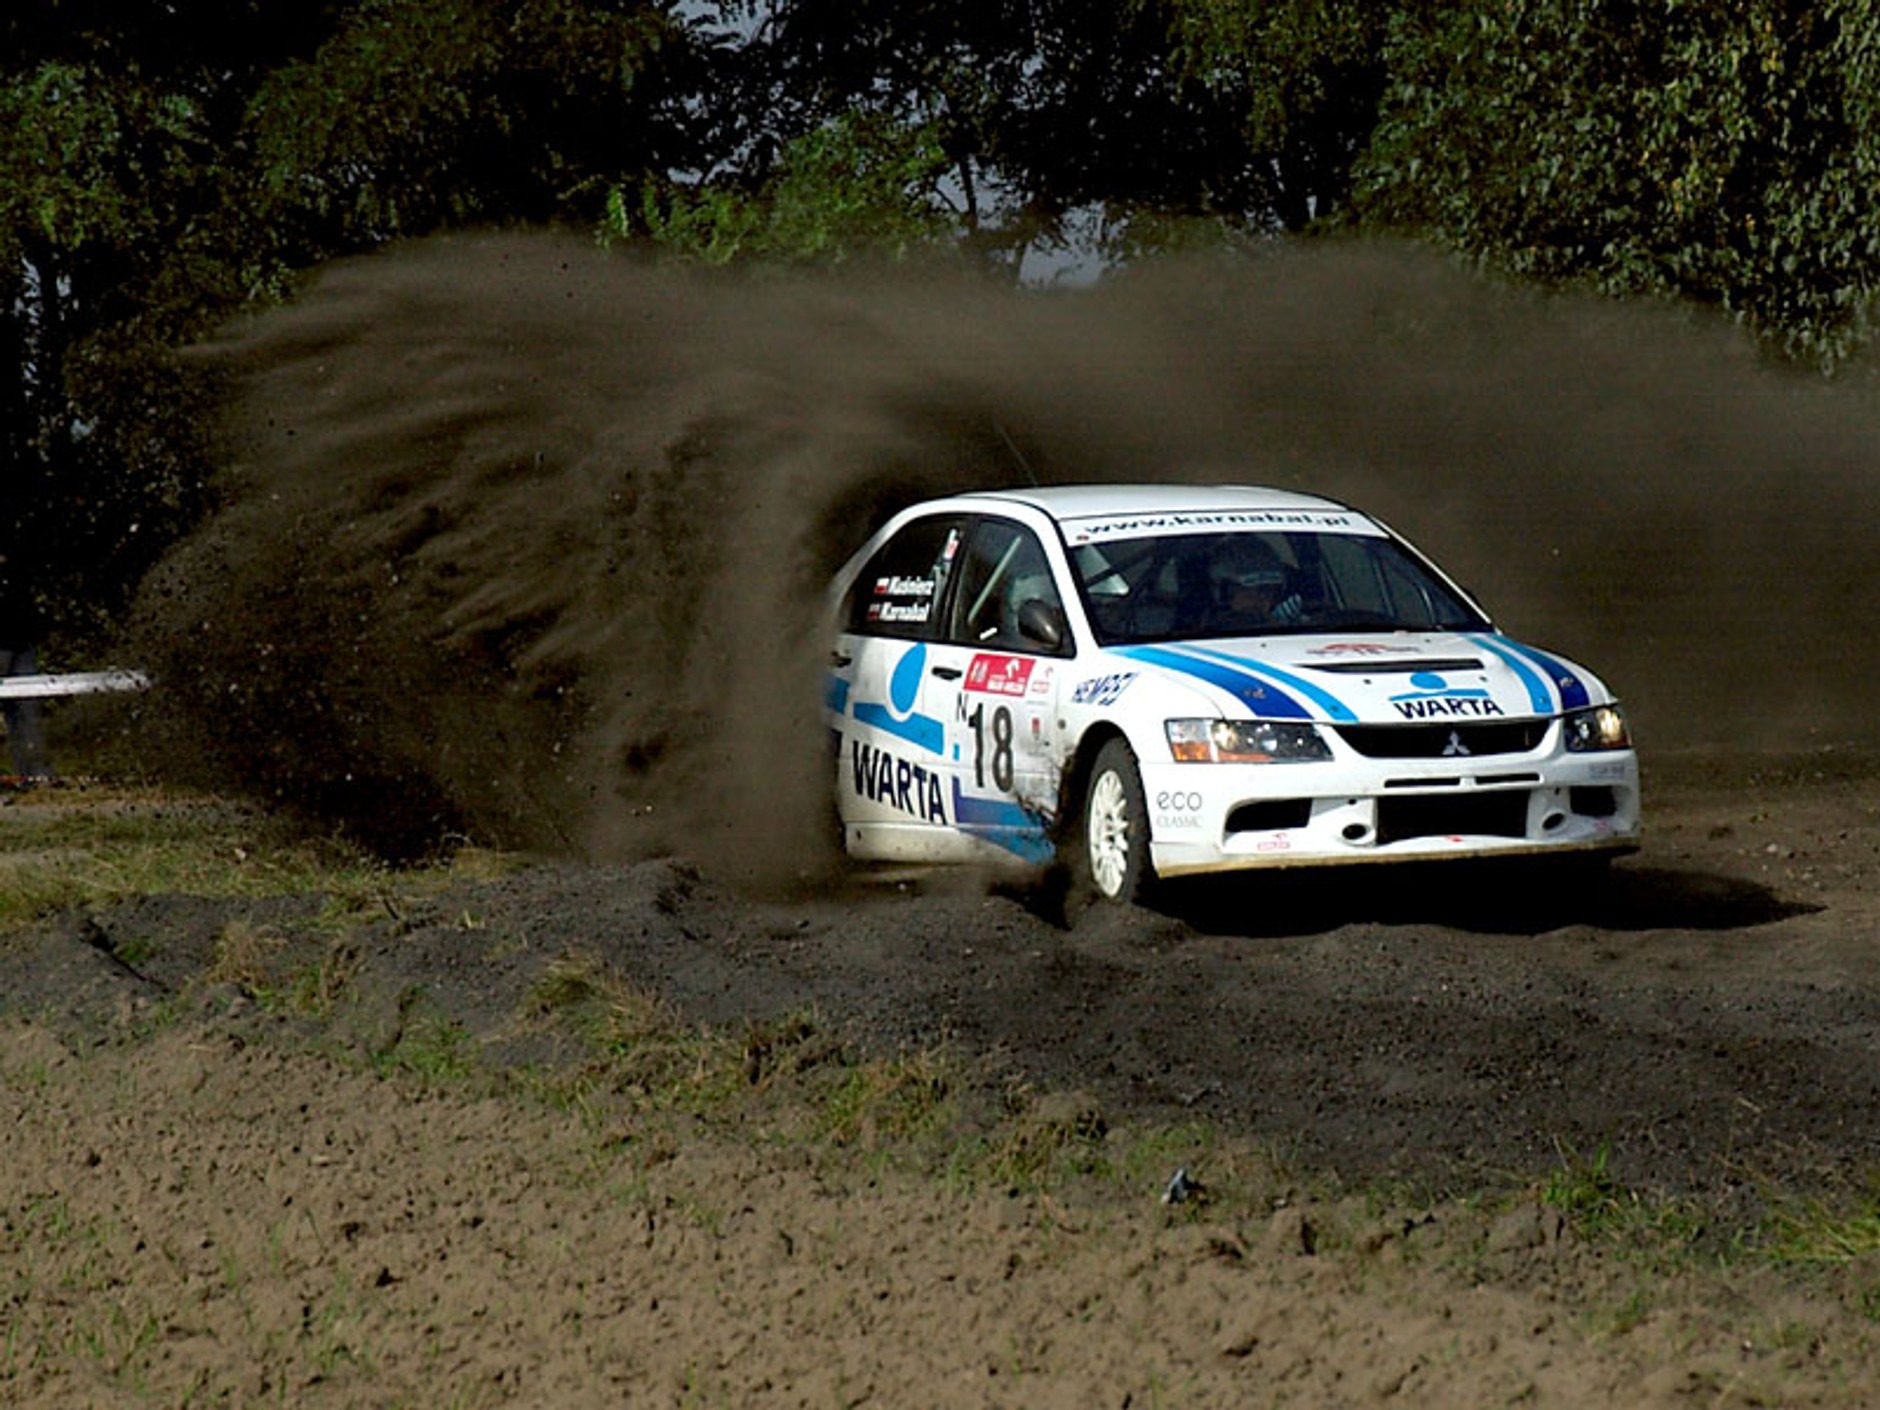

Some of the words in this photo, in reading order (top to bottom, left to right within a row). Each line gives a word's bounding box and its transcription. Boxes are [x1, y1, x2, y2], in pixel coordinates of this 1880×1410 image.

[1085, 512, 1351, 533] www.karnabal.pl
[1393, 698, 1505, 719] WARTA
[968, 702, 1013, 793] 18
[853, 740, 947, 826] WARTA
[1156, 791, 1203, 811] eco
